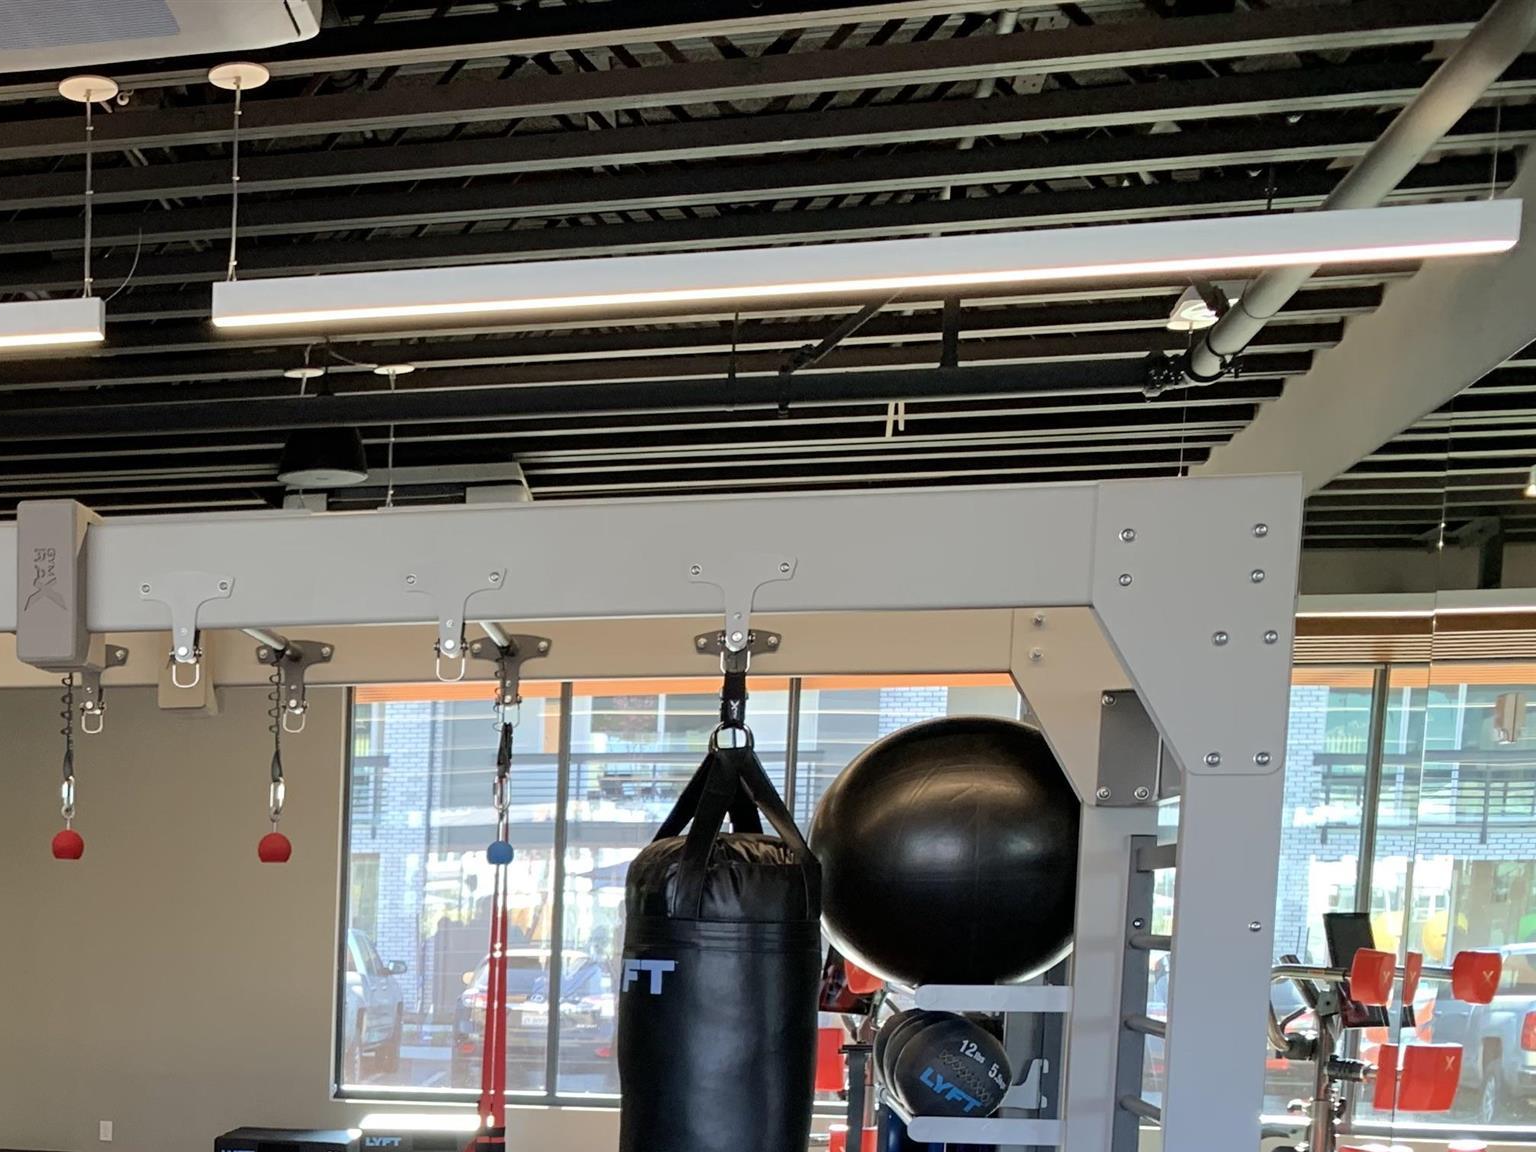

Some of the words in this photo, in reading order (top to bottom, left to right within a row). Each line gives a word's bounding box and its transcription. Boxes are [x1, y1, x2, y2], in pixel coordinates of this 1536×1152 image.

[623, 958, 679, 995] FT
[919, 1066, 983, 1113] LYFT
[364, 1136, 402, 1147] LYFT
